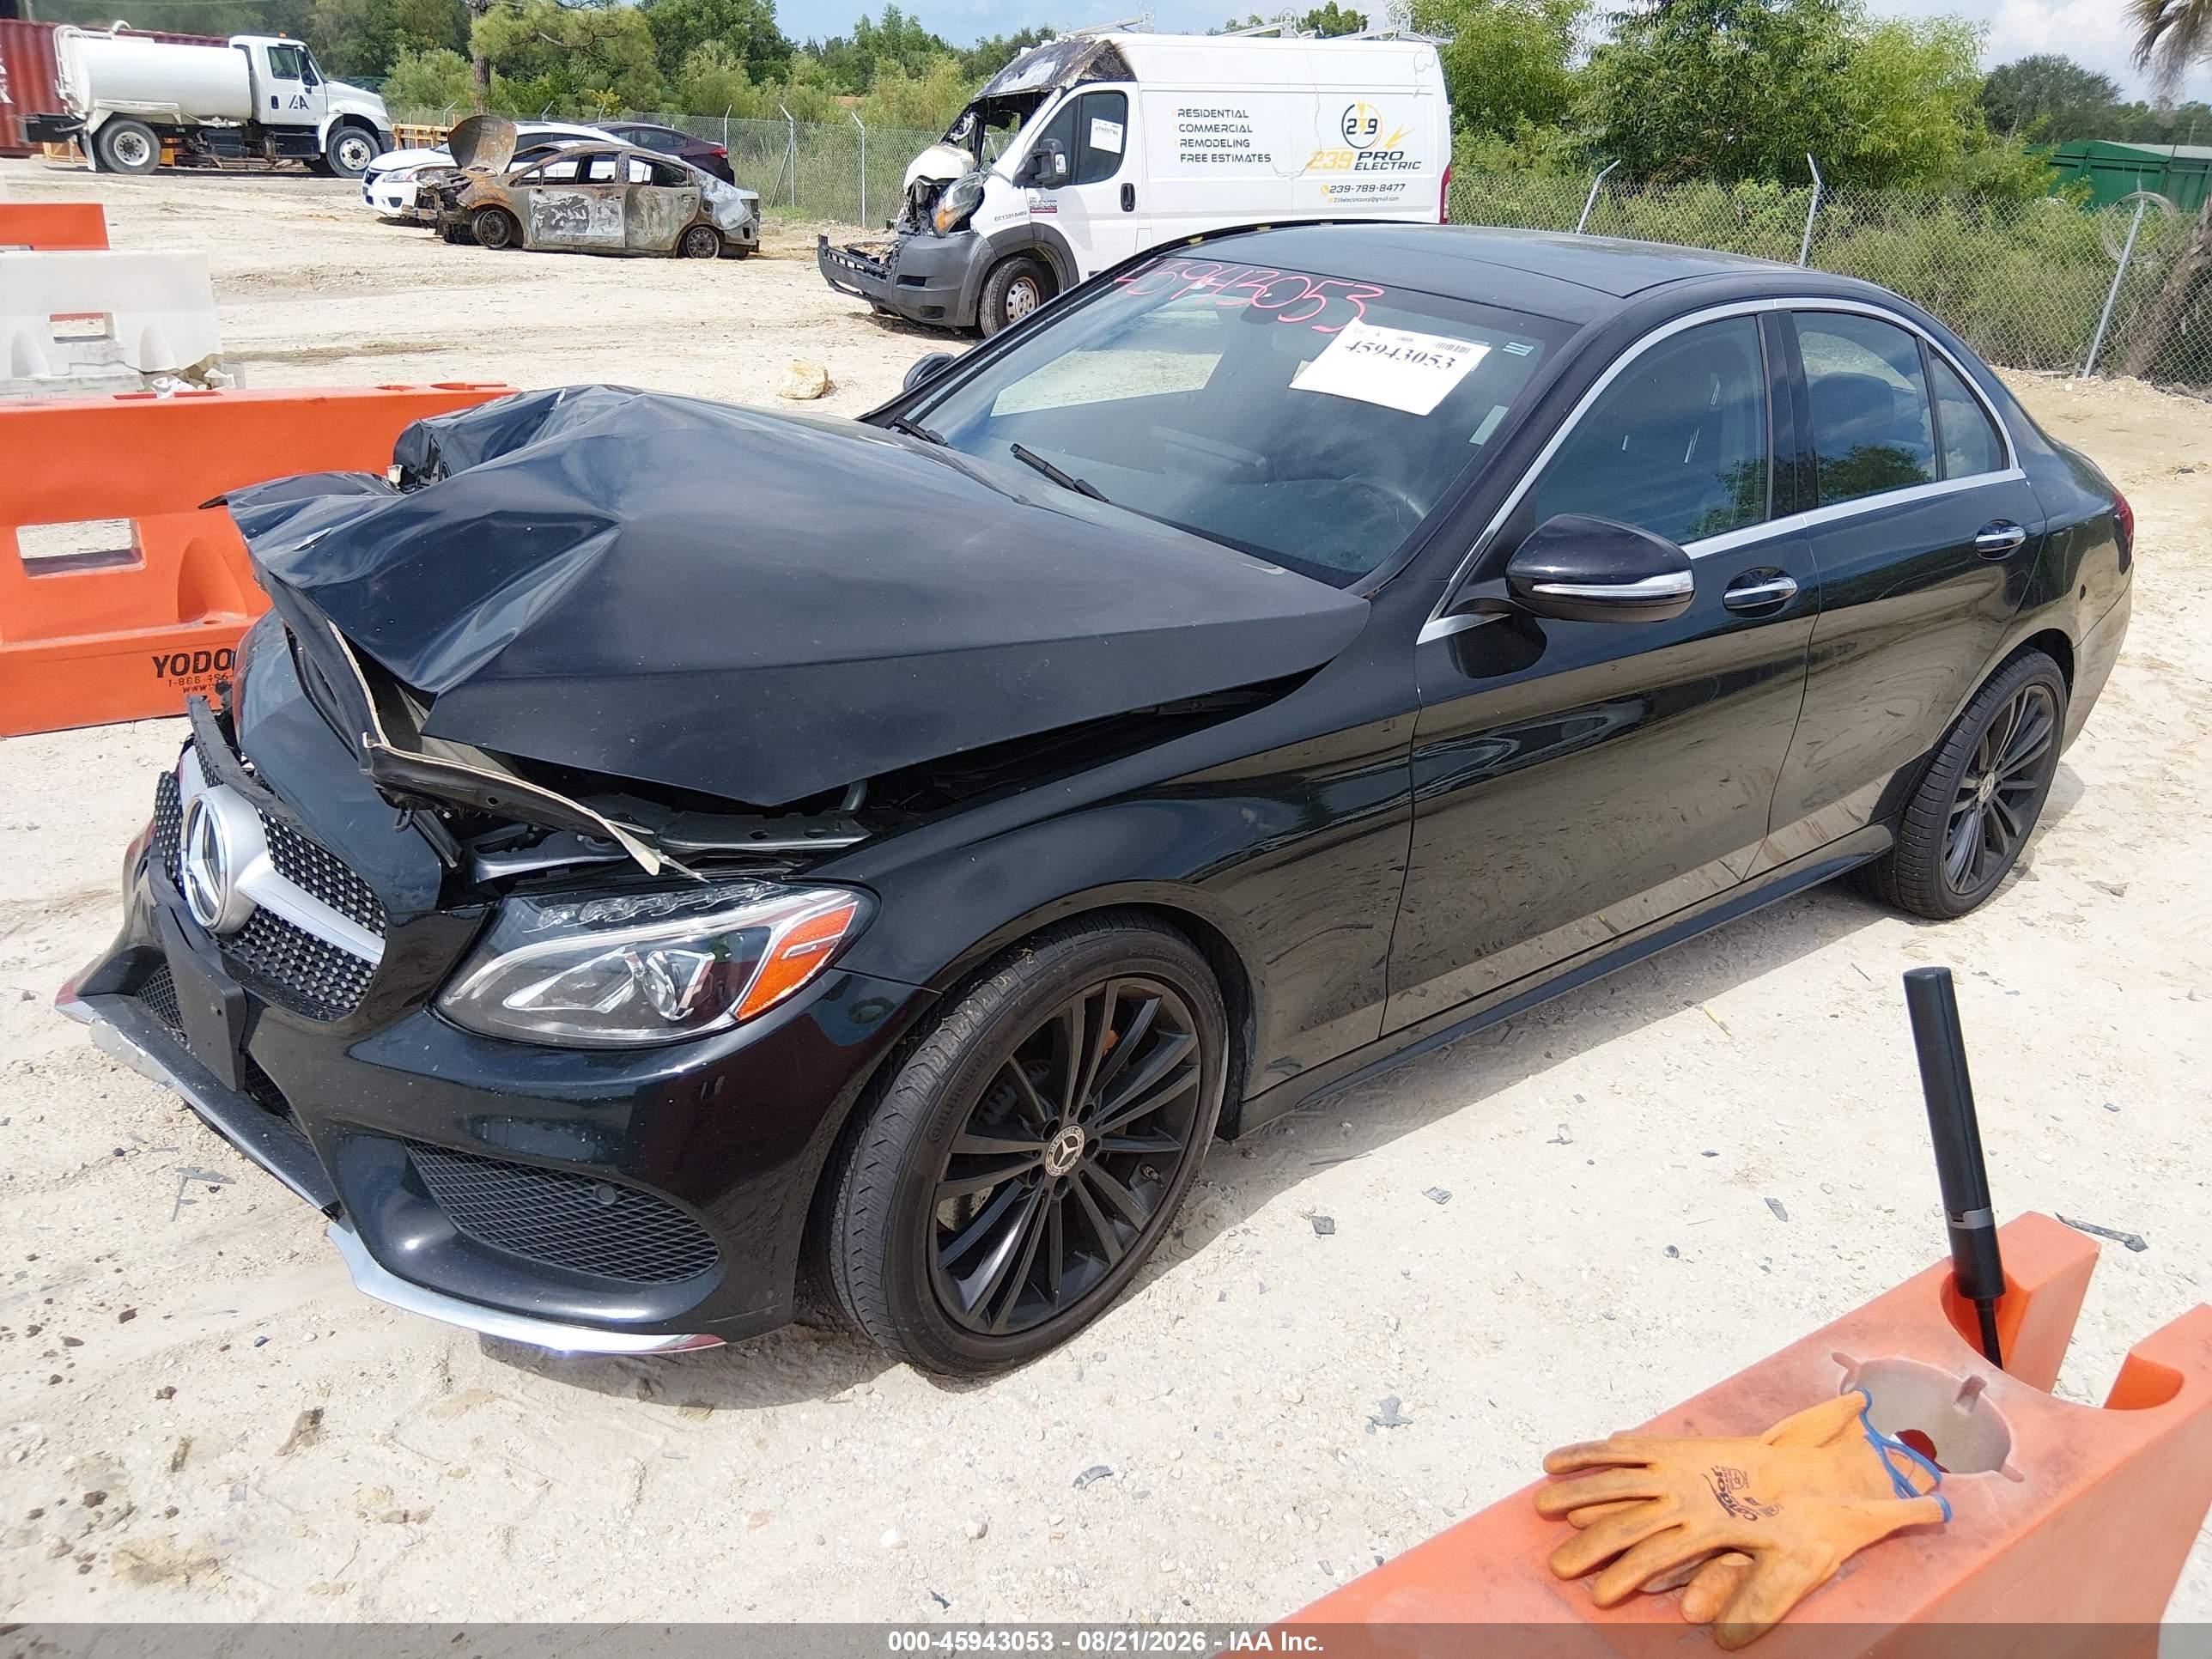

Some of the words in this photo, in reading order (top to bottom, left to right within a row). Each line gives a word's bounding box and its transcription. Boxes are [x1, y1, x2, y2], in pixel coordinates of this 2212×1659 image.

[1177, 108, 1249, 118] RESIDENTIAL
[1178, 124, 1254, 133] COMMERCIAL
[1180, 138, 1250, 149] REMODELING
[1180, 154, 1208, 163] FREE
[1211, 154, 1272, 163] ESTIMATES
[1306, 150, 1354, 170] 239
[1357, 151, 1405, 161] PRO
[1353, 161, 1422, 171] ELECTRIC
[1328, 183, 1406, 194] 239-789-8477
[1344, 339, 1457, 370] 45943053
[151, 647, 237, 678] YODO
